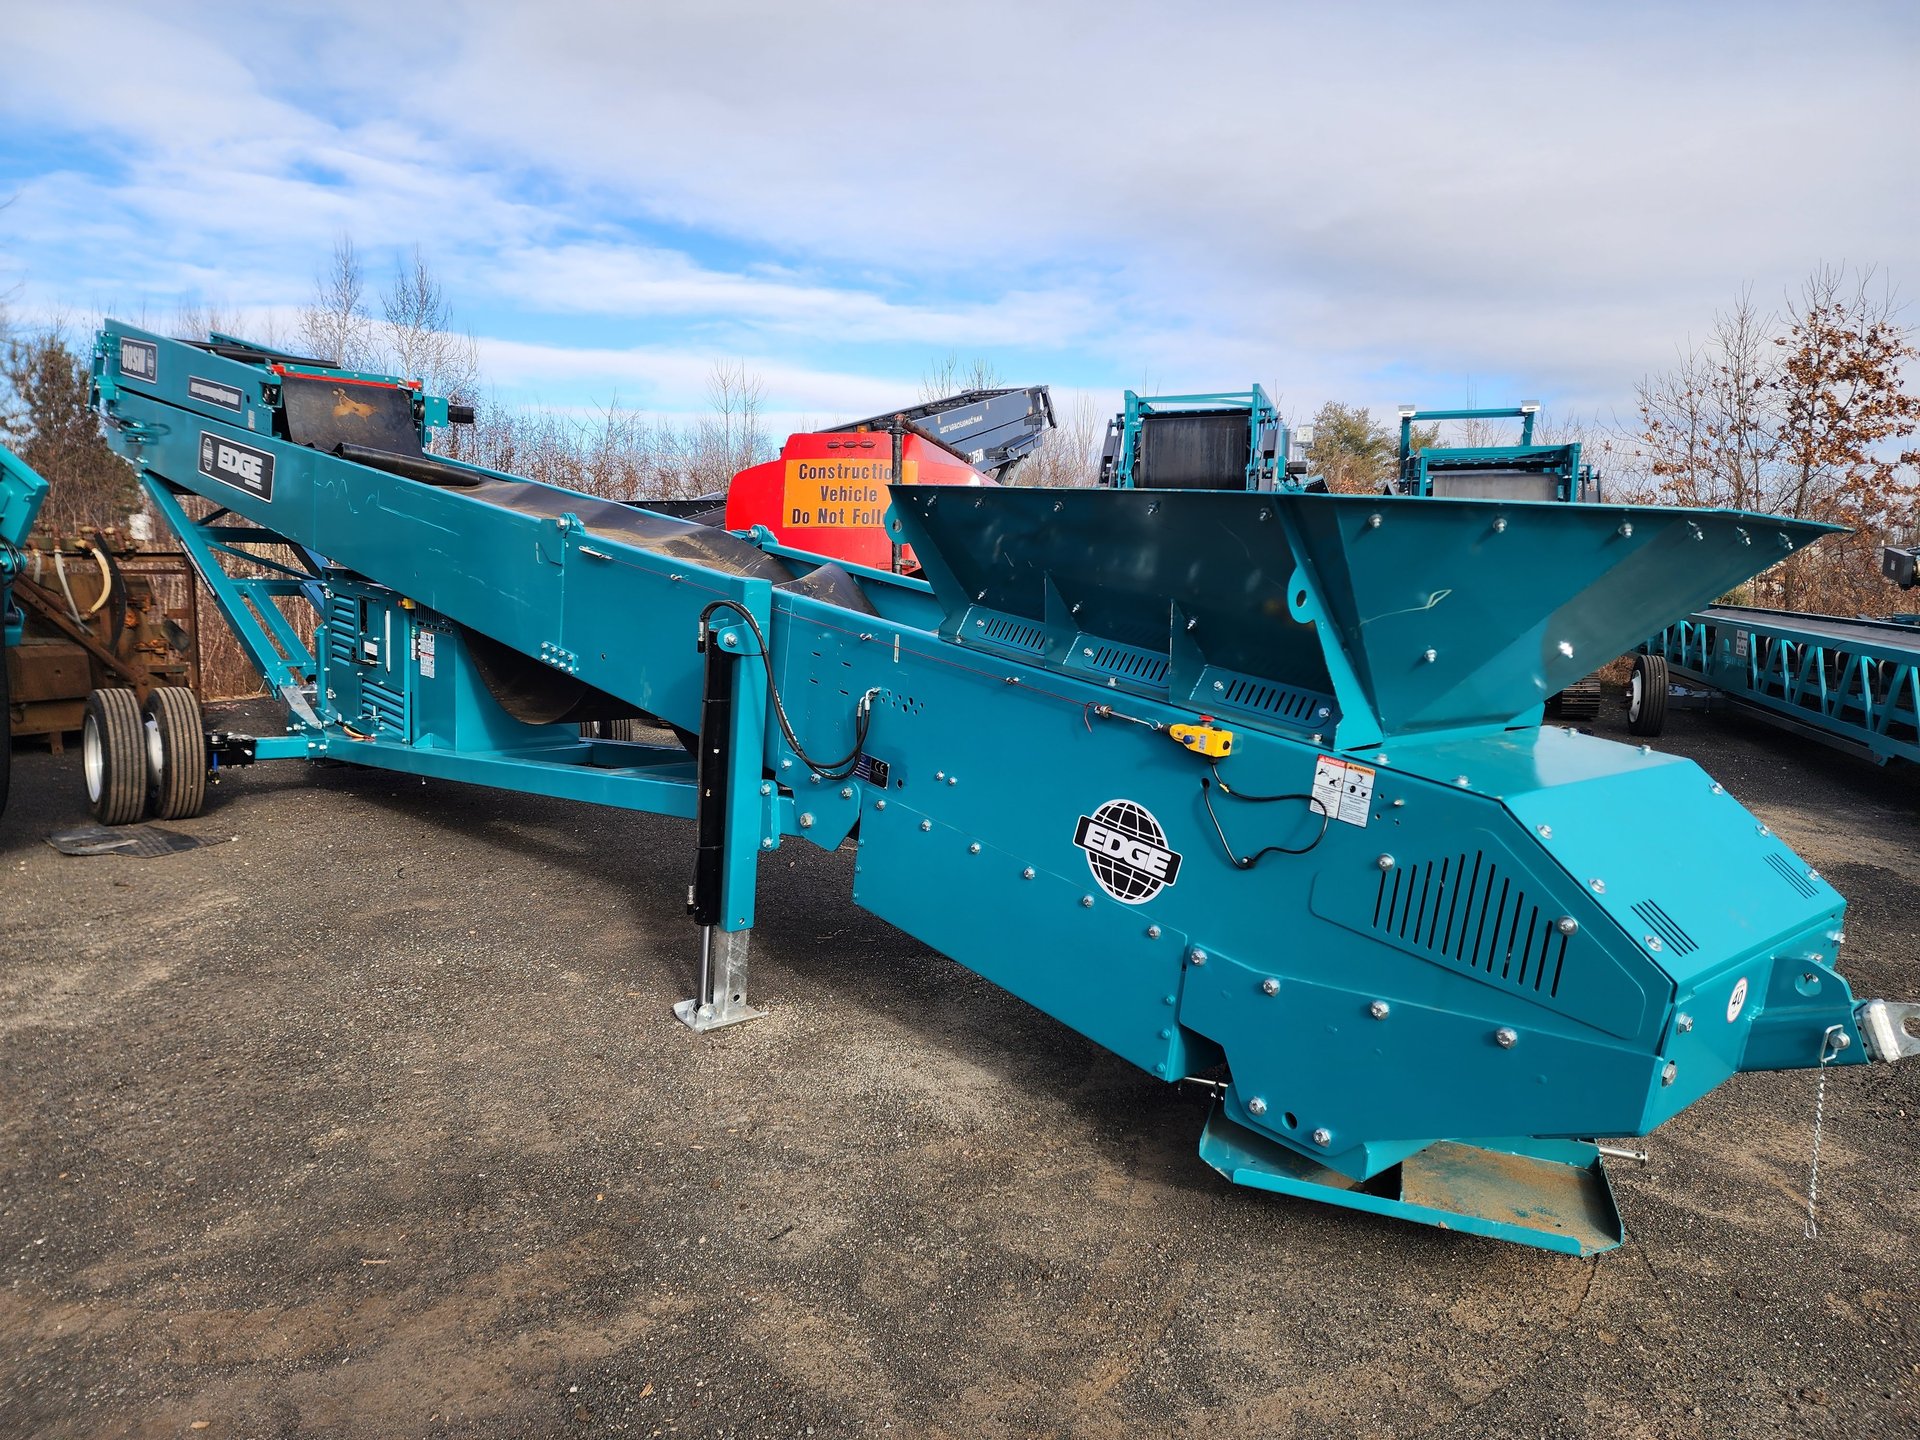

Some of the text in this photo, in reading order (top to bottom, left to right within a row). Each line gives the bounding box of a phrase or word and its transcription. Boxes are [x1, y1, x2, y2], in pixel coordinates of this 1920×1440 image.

[217, 443, 264, 483] EDGE
[799, 463, 892, 480] Constructio
[820, 485, 878, 502] Vehicle
[792, 508, 885, 525] Do Not Foll
[1083, 822, 1172, 879] EDGE
[1732, 989, 1743, 1006] 40
